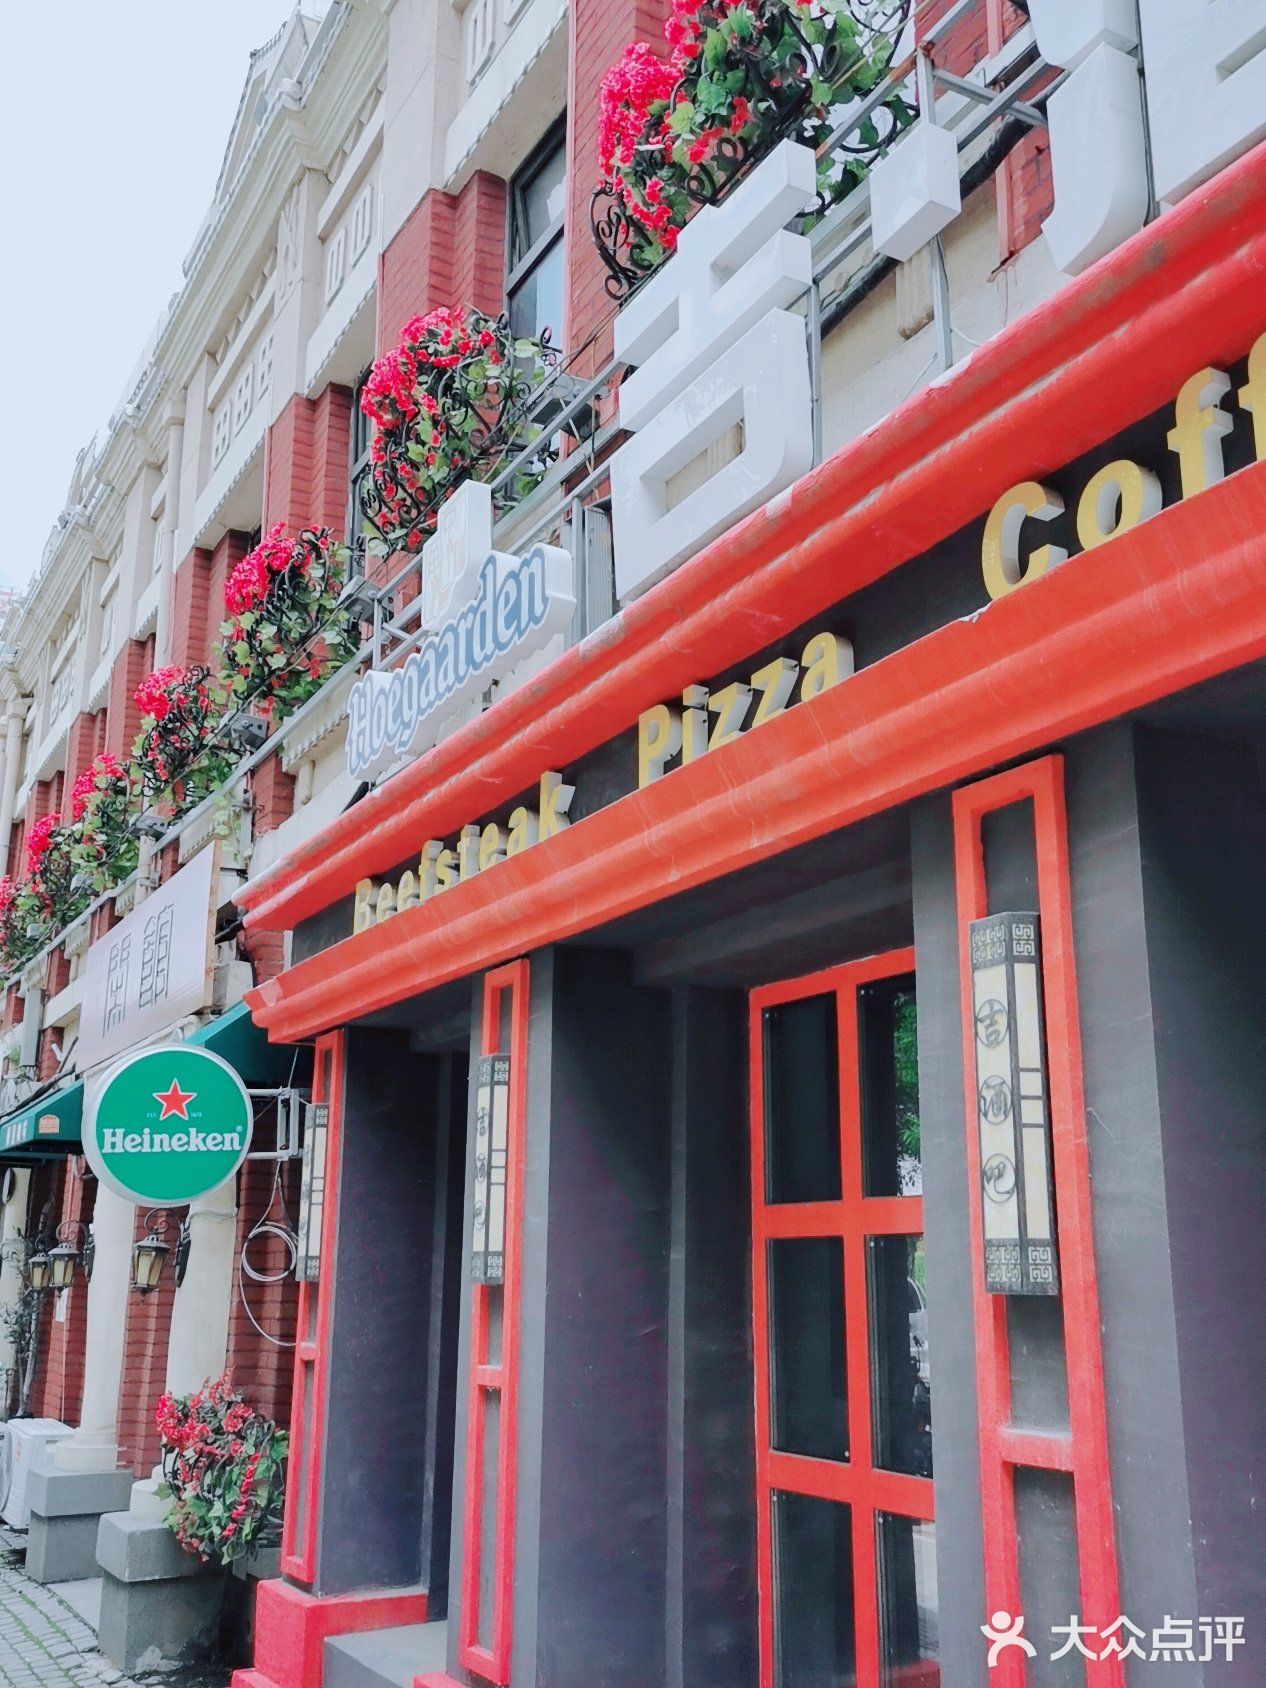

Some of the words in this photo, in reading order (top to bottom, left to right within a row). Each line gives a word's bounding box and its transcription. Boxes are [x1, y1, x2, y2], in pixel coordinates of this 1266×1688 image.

[346, 547, 550, 776] Hoegaarden
[353, 771, 574, 934] Beefsteak
[637, 631, 855, 789] Pizza
[102, 1127, 242, 1154] Heineken
